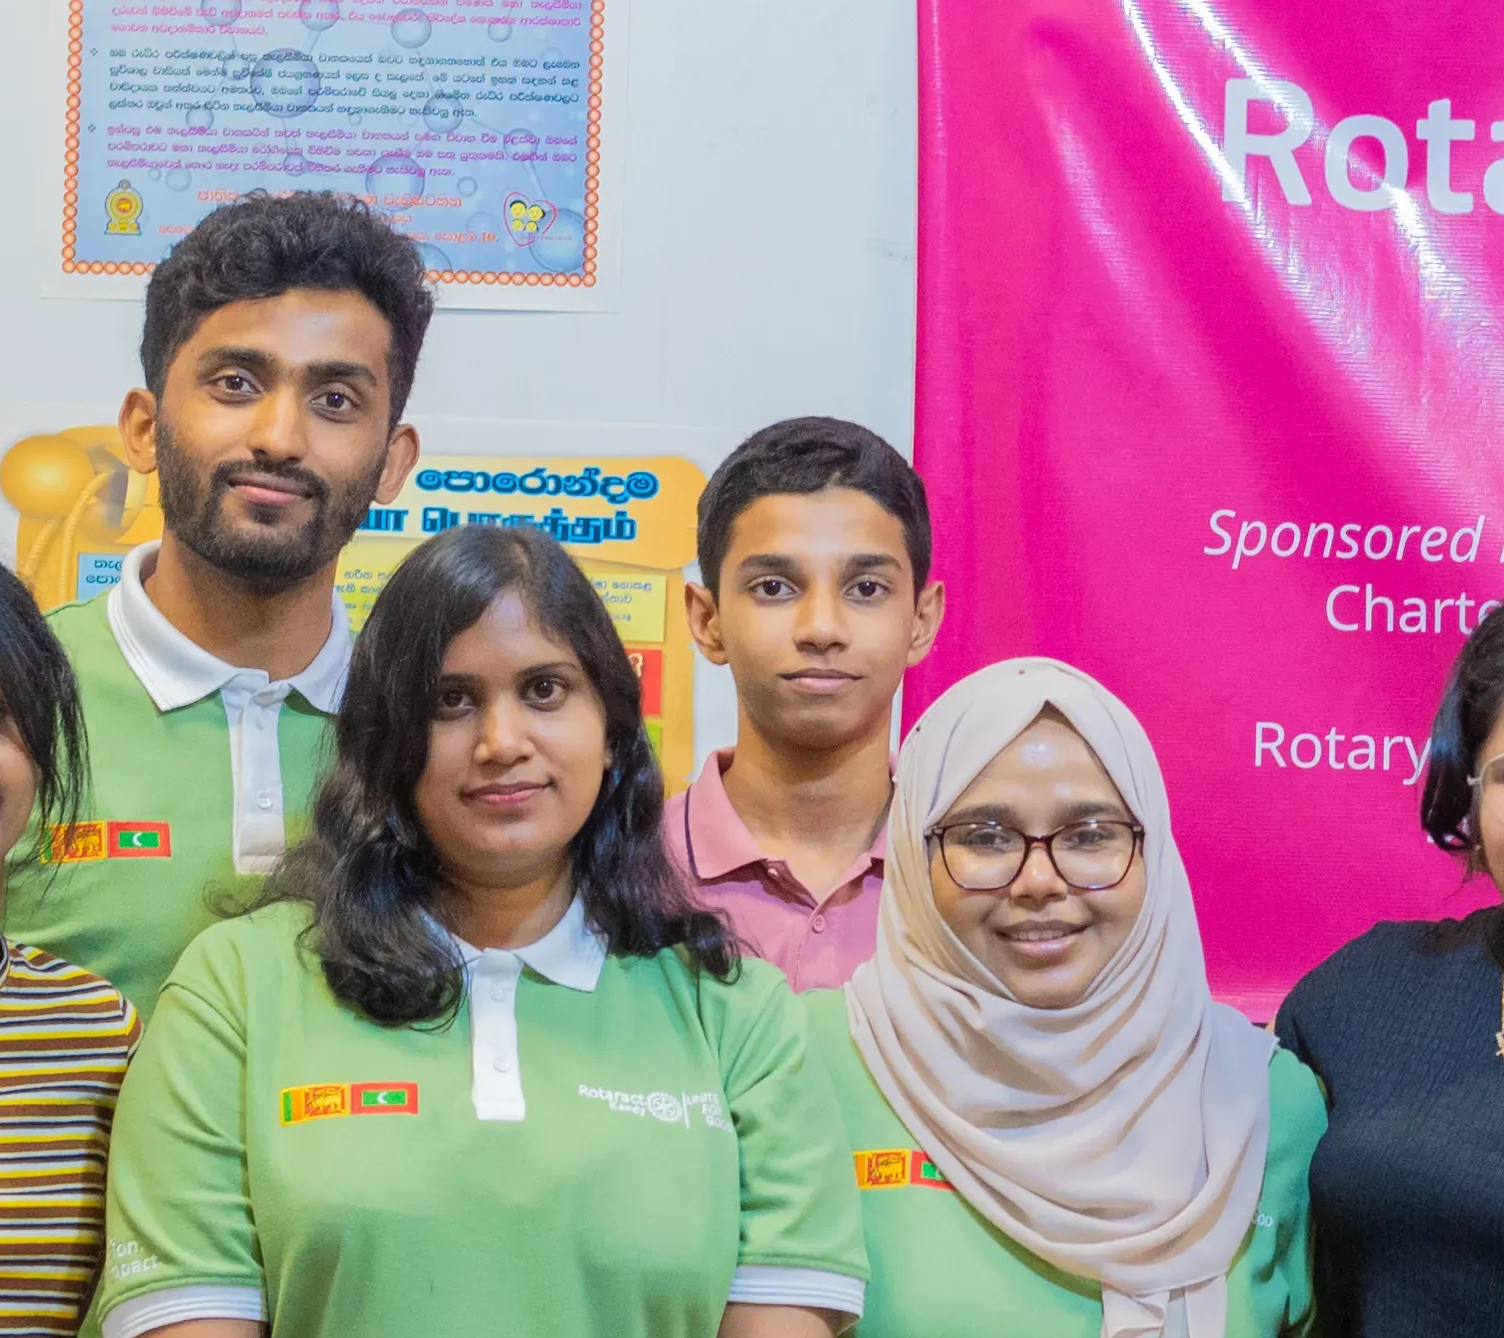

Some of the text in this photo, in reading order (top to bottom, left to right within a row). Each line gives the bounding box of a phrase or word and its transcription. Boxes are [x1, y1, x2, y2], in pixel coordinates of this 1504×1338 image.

[1203, 508, 1486, 570] Sponsored
[1253, 720, 1432, 786] Rotary
[577, 1084, 647, 1107] Rotaract
